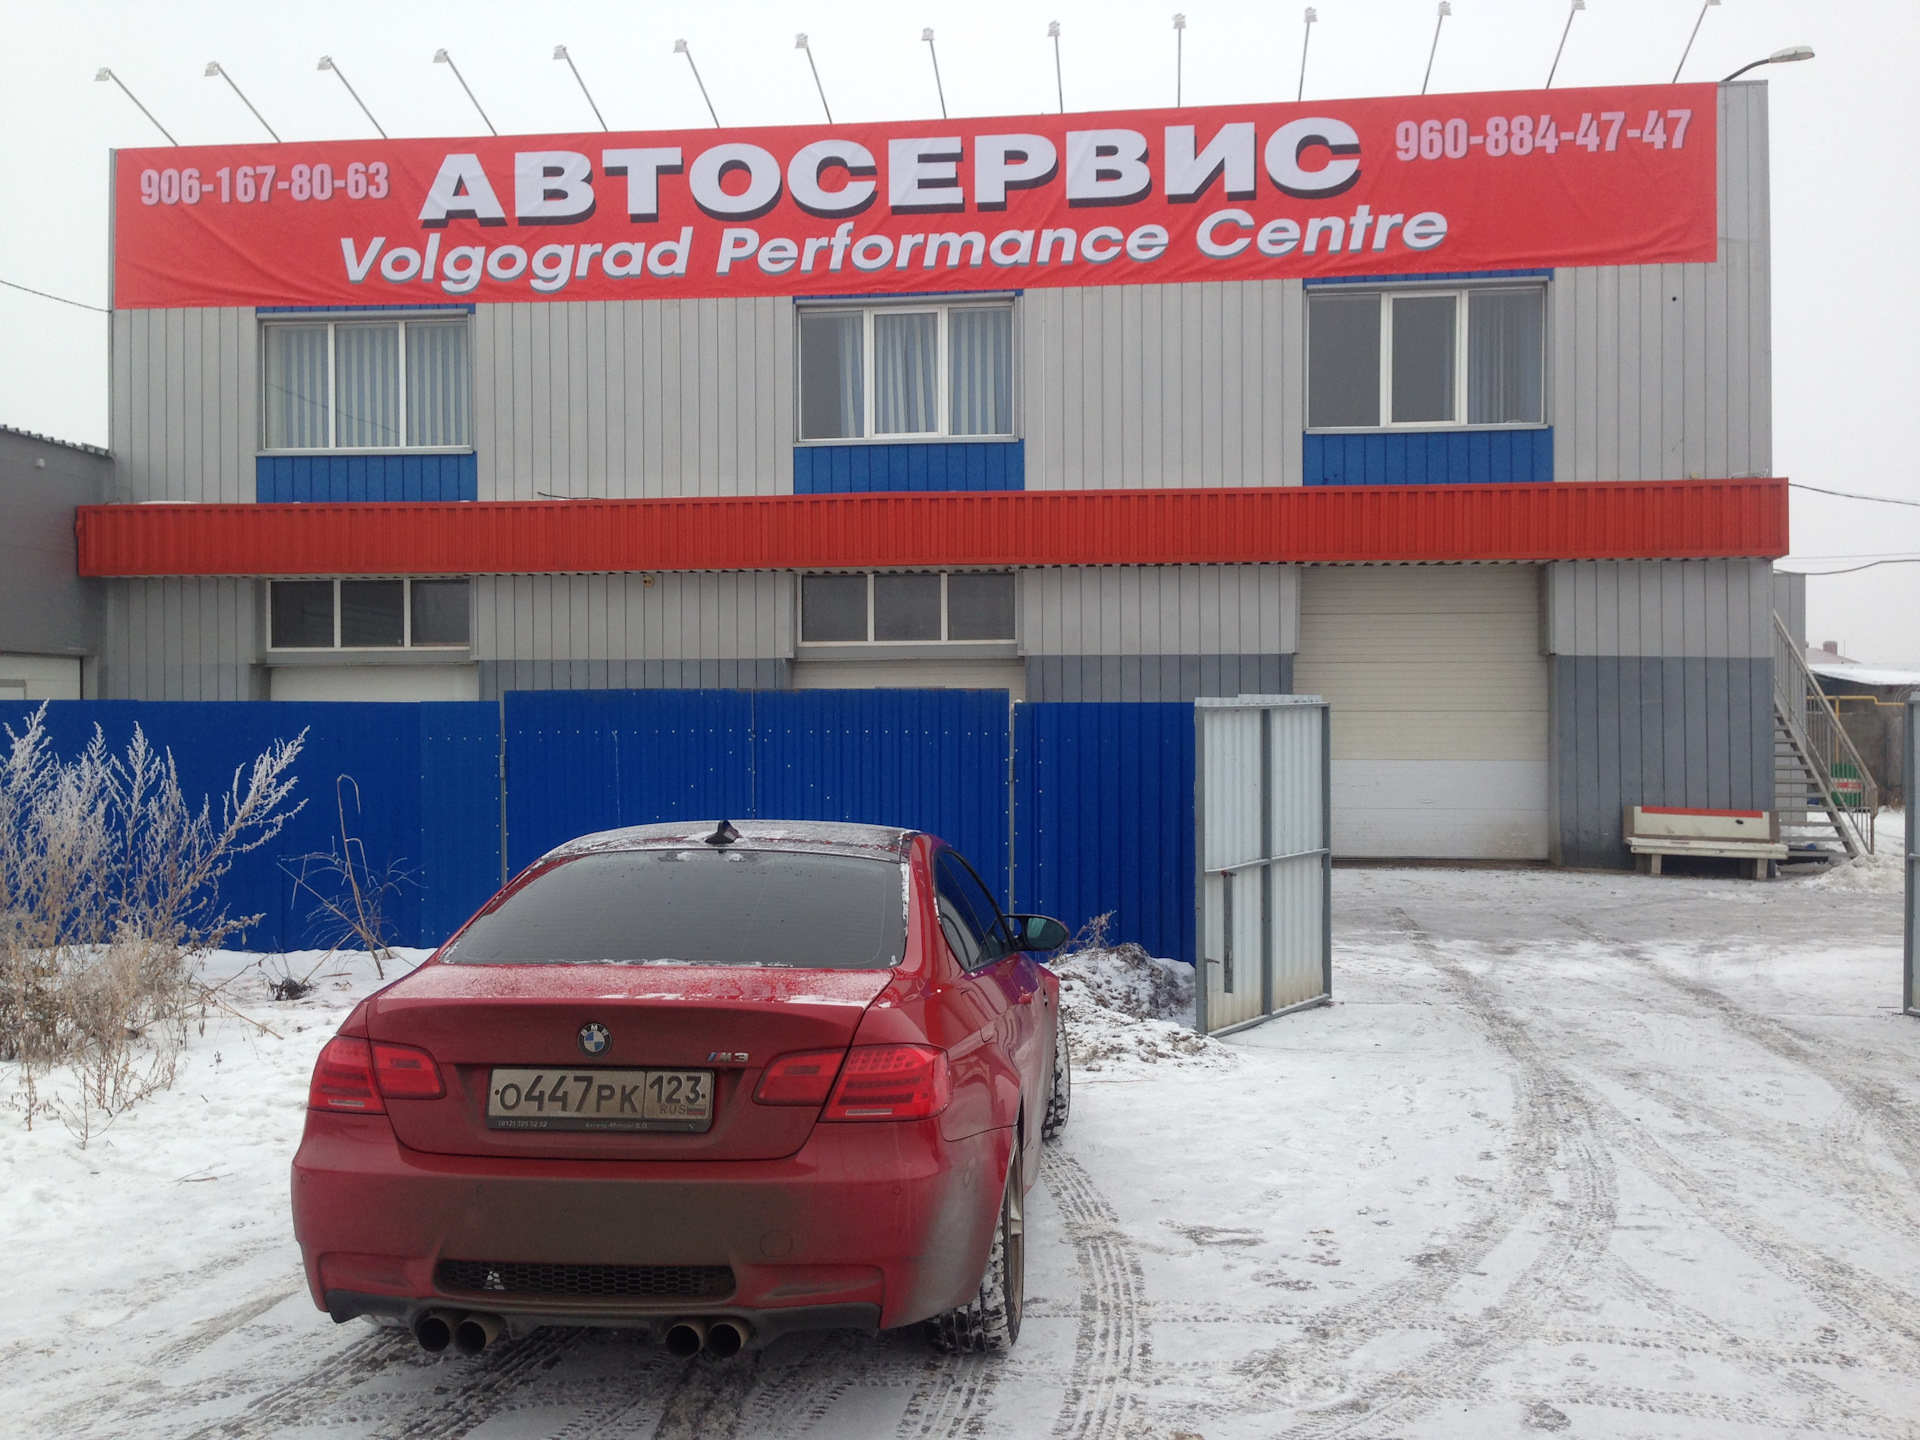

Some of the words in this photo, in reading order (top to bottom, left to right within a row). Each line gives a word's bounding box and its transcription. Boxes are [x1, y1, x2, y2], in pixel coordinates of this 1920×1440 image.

[1396, 108, 1692, 161] 960-884-47-47
[140, 162, 390, 206] 906-167-80-63
[418, 117, 1361, 228] АВТОСЕРВИС
[341, 227, 692, 294] Volgograd
[717, 222, 1169, 276] Performance
[1196, 204, 1449, 259] Centre
[580, 1024, 609, 1037] BMW
[707, 1051, 749, 1063] M3
[649, 1075, 702, 1104] 123
[659, 1104, 686, 1115] RUS
